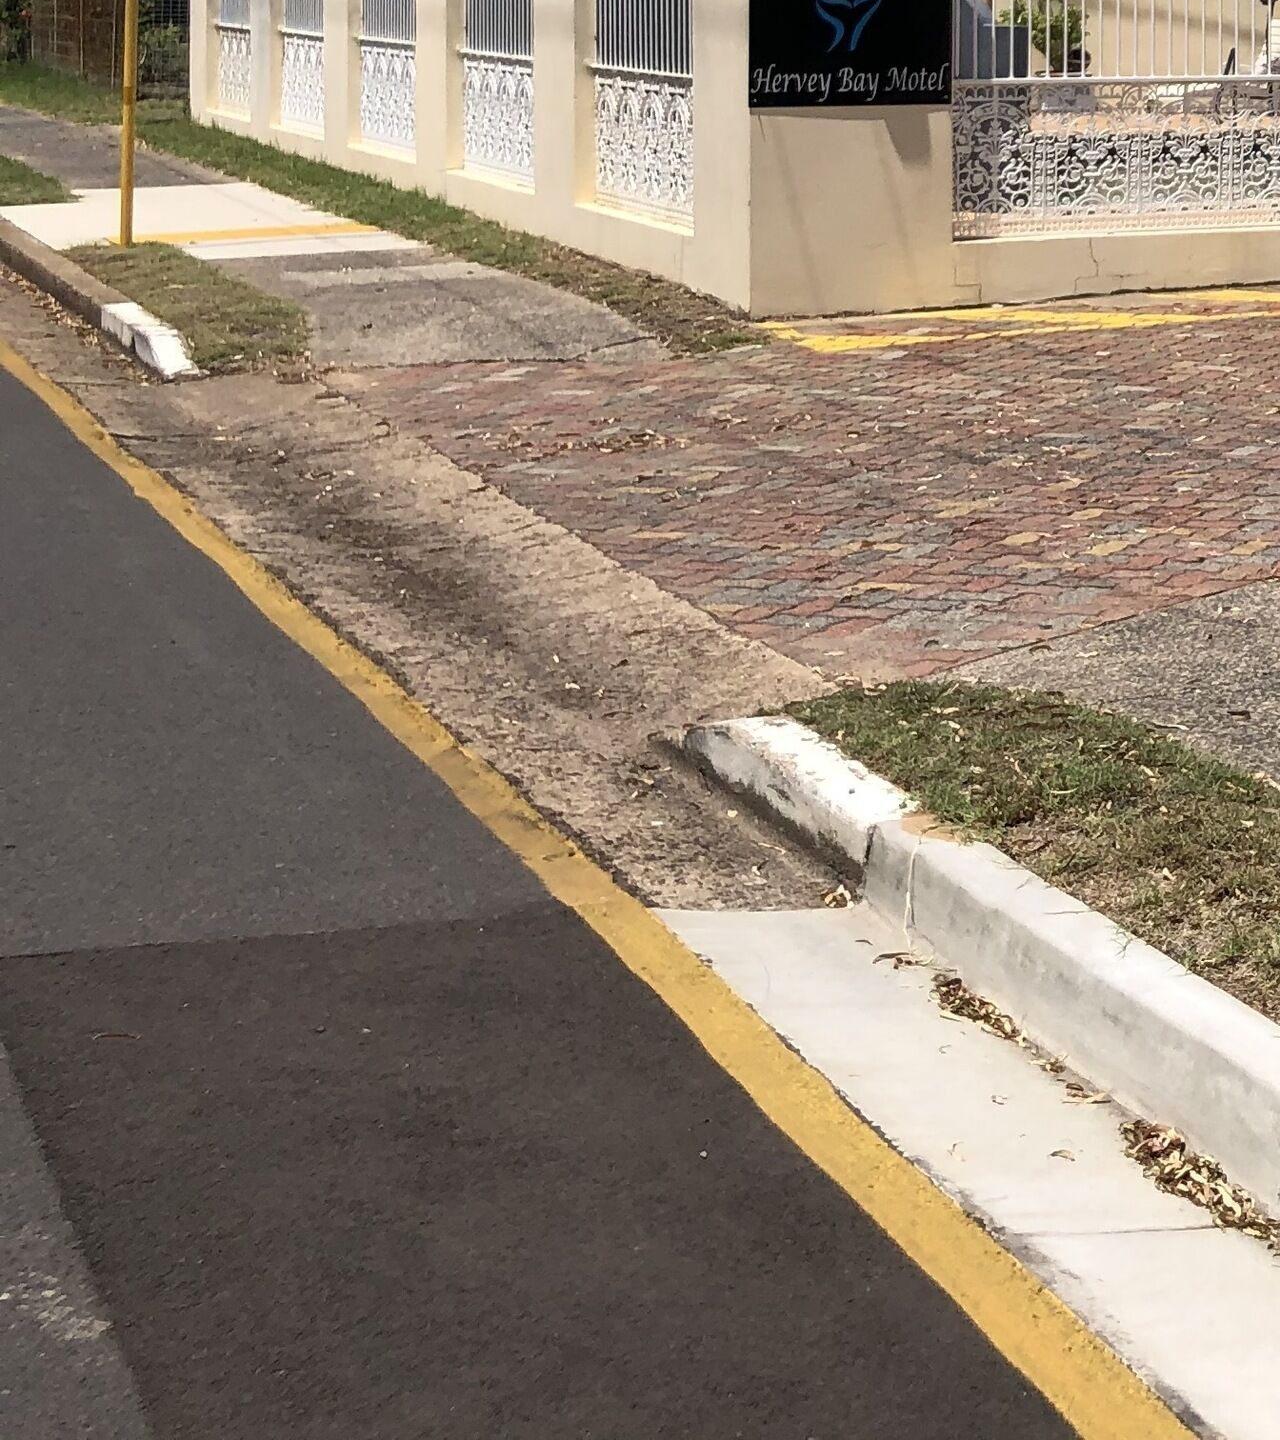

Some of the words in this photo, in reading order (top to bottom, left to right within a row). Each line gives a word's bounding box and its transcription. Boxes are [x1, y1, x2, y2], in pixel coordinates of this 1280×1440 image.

[750, 63, 831, 103] Hervey
[837, 66, 880, 102] Bay
[885, 62, 950, 92] Motel
